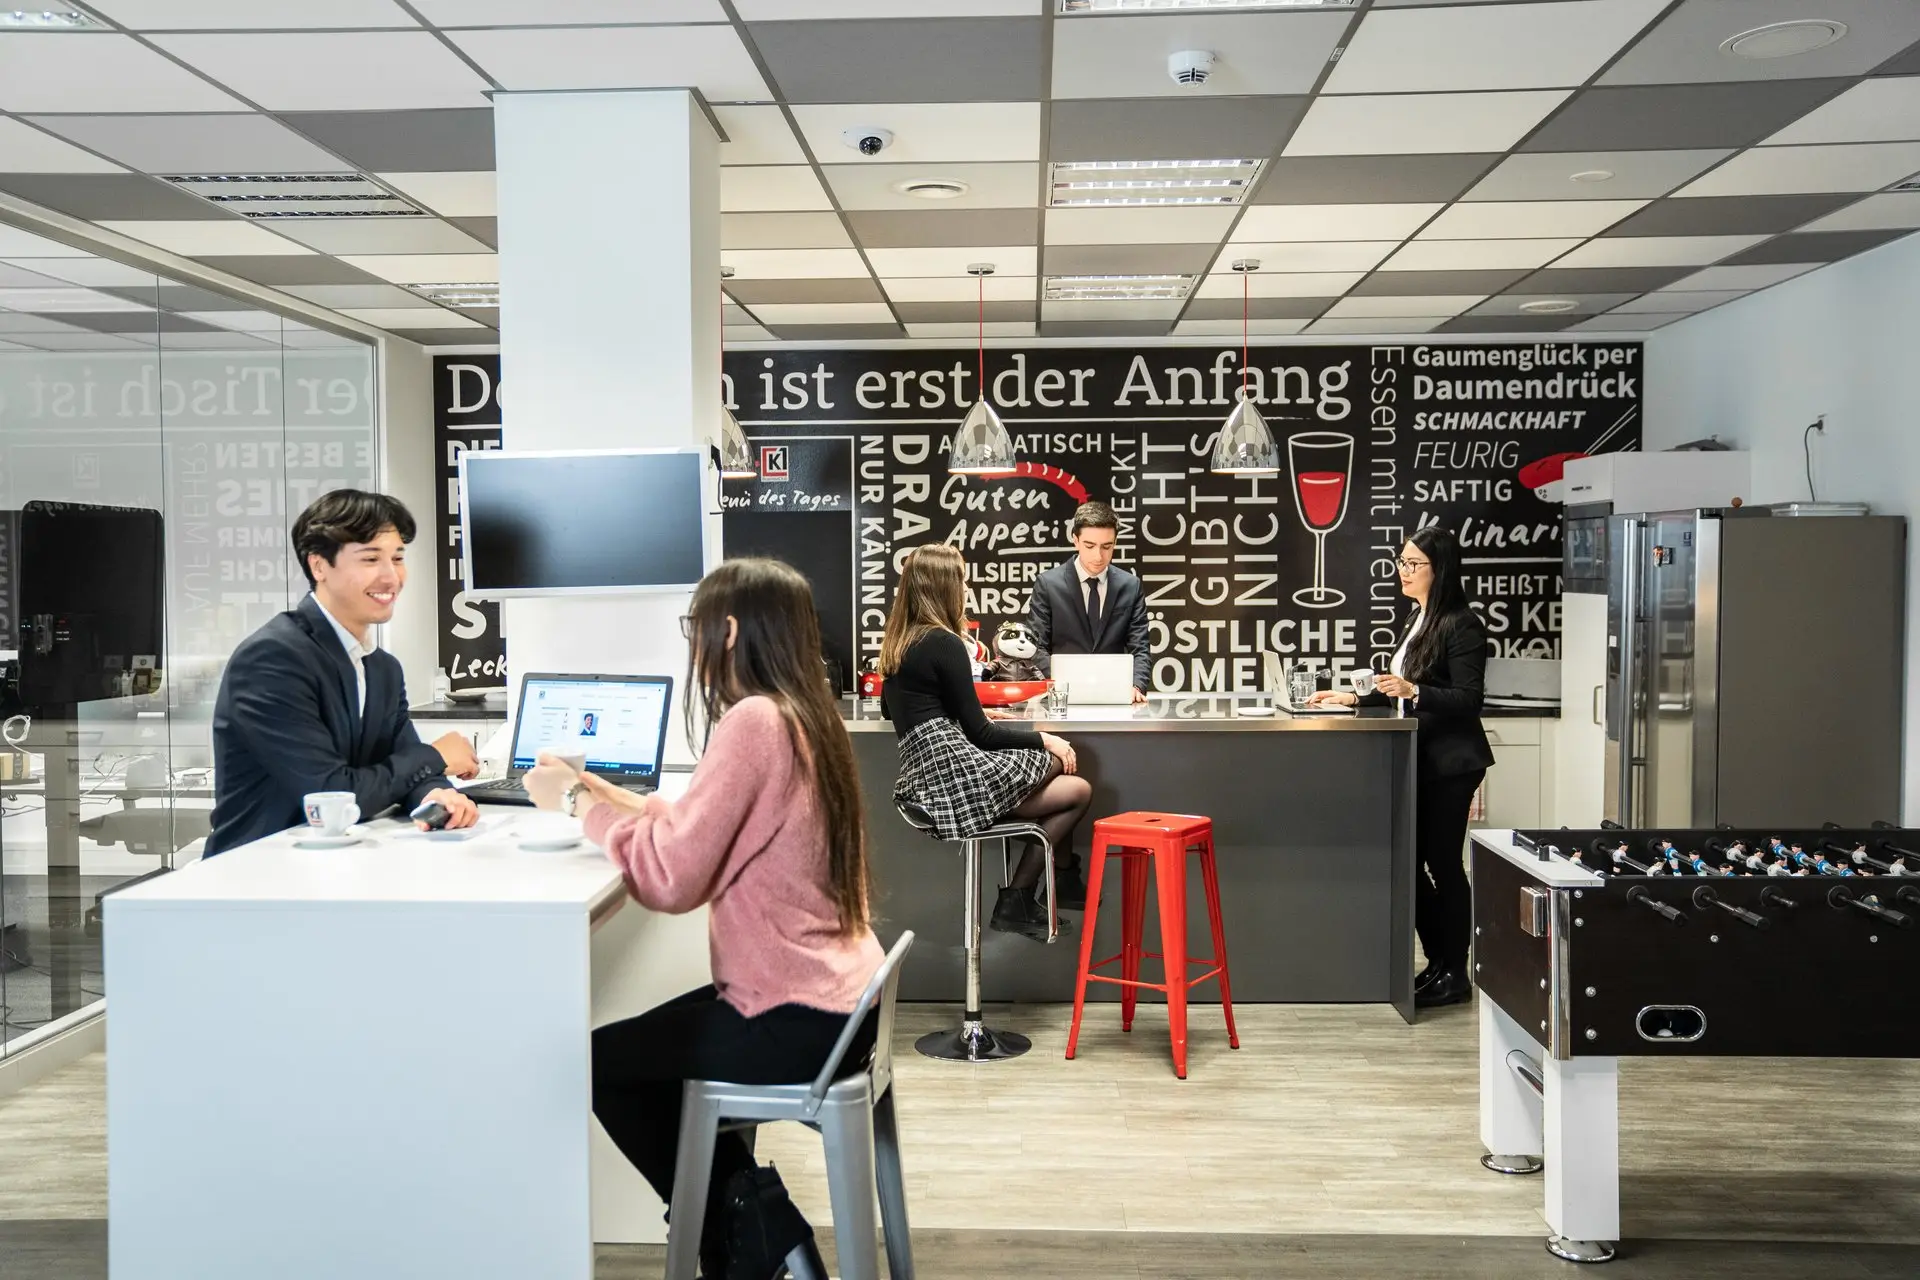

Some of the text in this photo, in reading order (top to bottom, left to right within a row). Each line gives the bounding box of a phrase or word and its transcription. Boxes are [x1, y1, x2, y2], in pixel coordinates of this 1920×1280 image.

[1413, 343, 1637, 371] Gaumenglück per
[759, 358, 835, 410] ist
[855, 361, 972, 409] erst
[993, 354, 1096, 408] der
[1114, 351, 1352, 420] Anfang
[1371, 346, 1404, 445] Essen
[1413, 371, 1637, 400] Daumendrück
[1413, 410, 1587, 430] SCHMACKHAFT
[860, 435, 884, 504] NUR
[1413, 440, 1520, 469] FEURIG
[721, 489, 841, 511] enü des Tages
[940, 474, 1050, 515] Guten
[1371, 459, 1405, 516] mit
[1413, 479, 1513, 502] SAFTIG
[1142, 432, 1186, 606] NICHT
[1234, 473, 1279, 606] NICH
[1147, 612, 1356, 653] ÖSTLICHE
[451, 654, 507, 680] Leck
[1152, 657, 1356, 693] OMENTE
